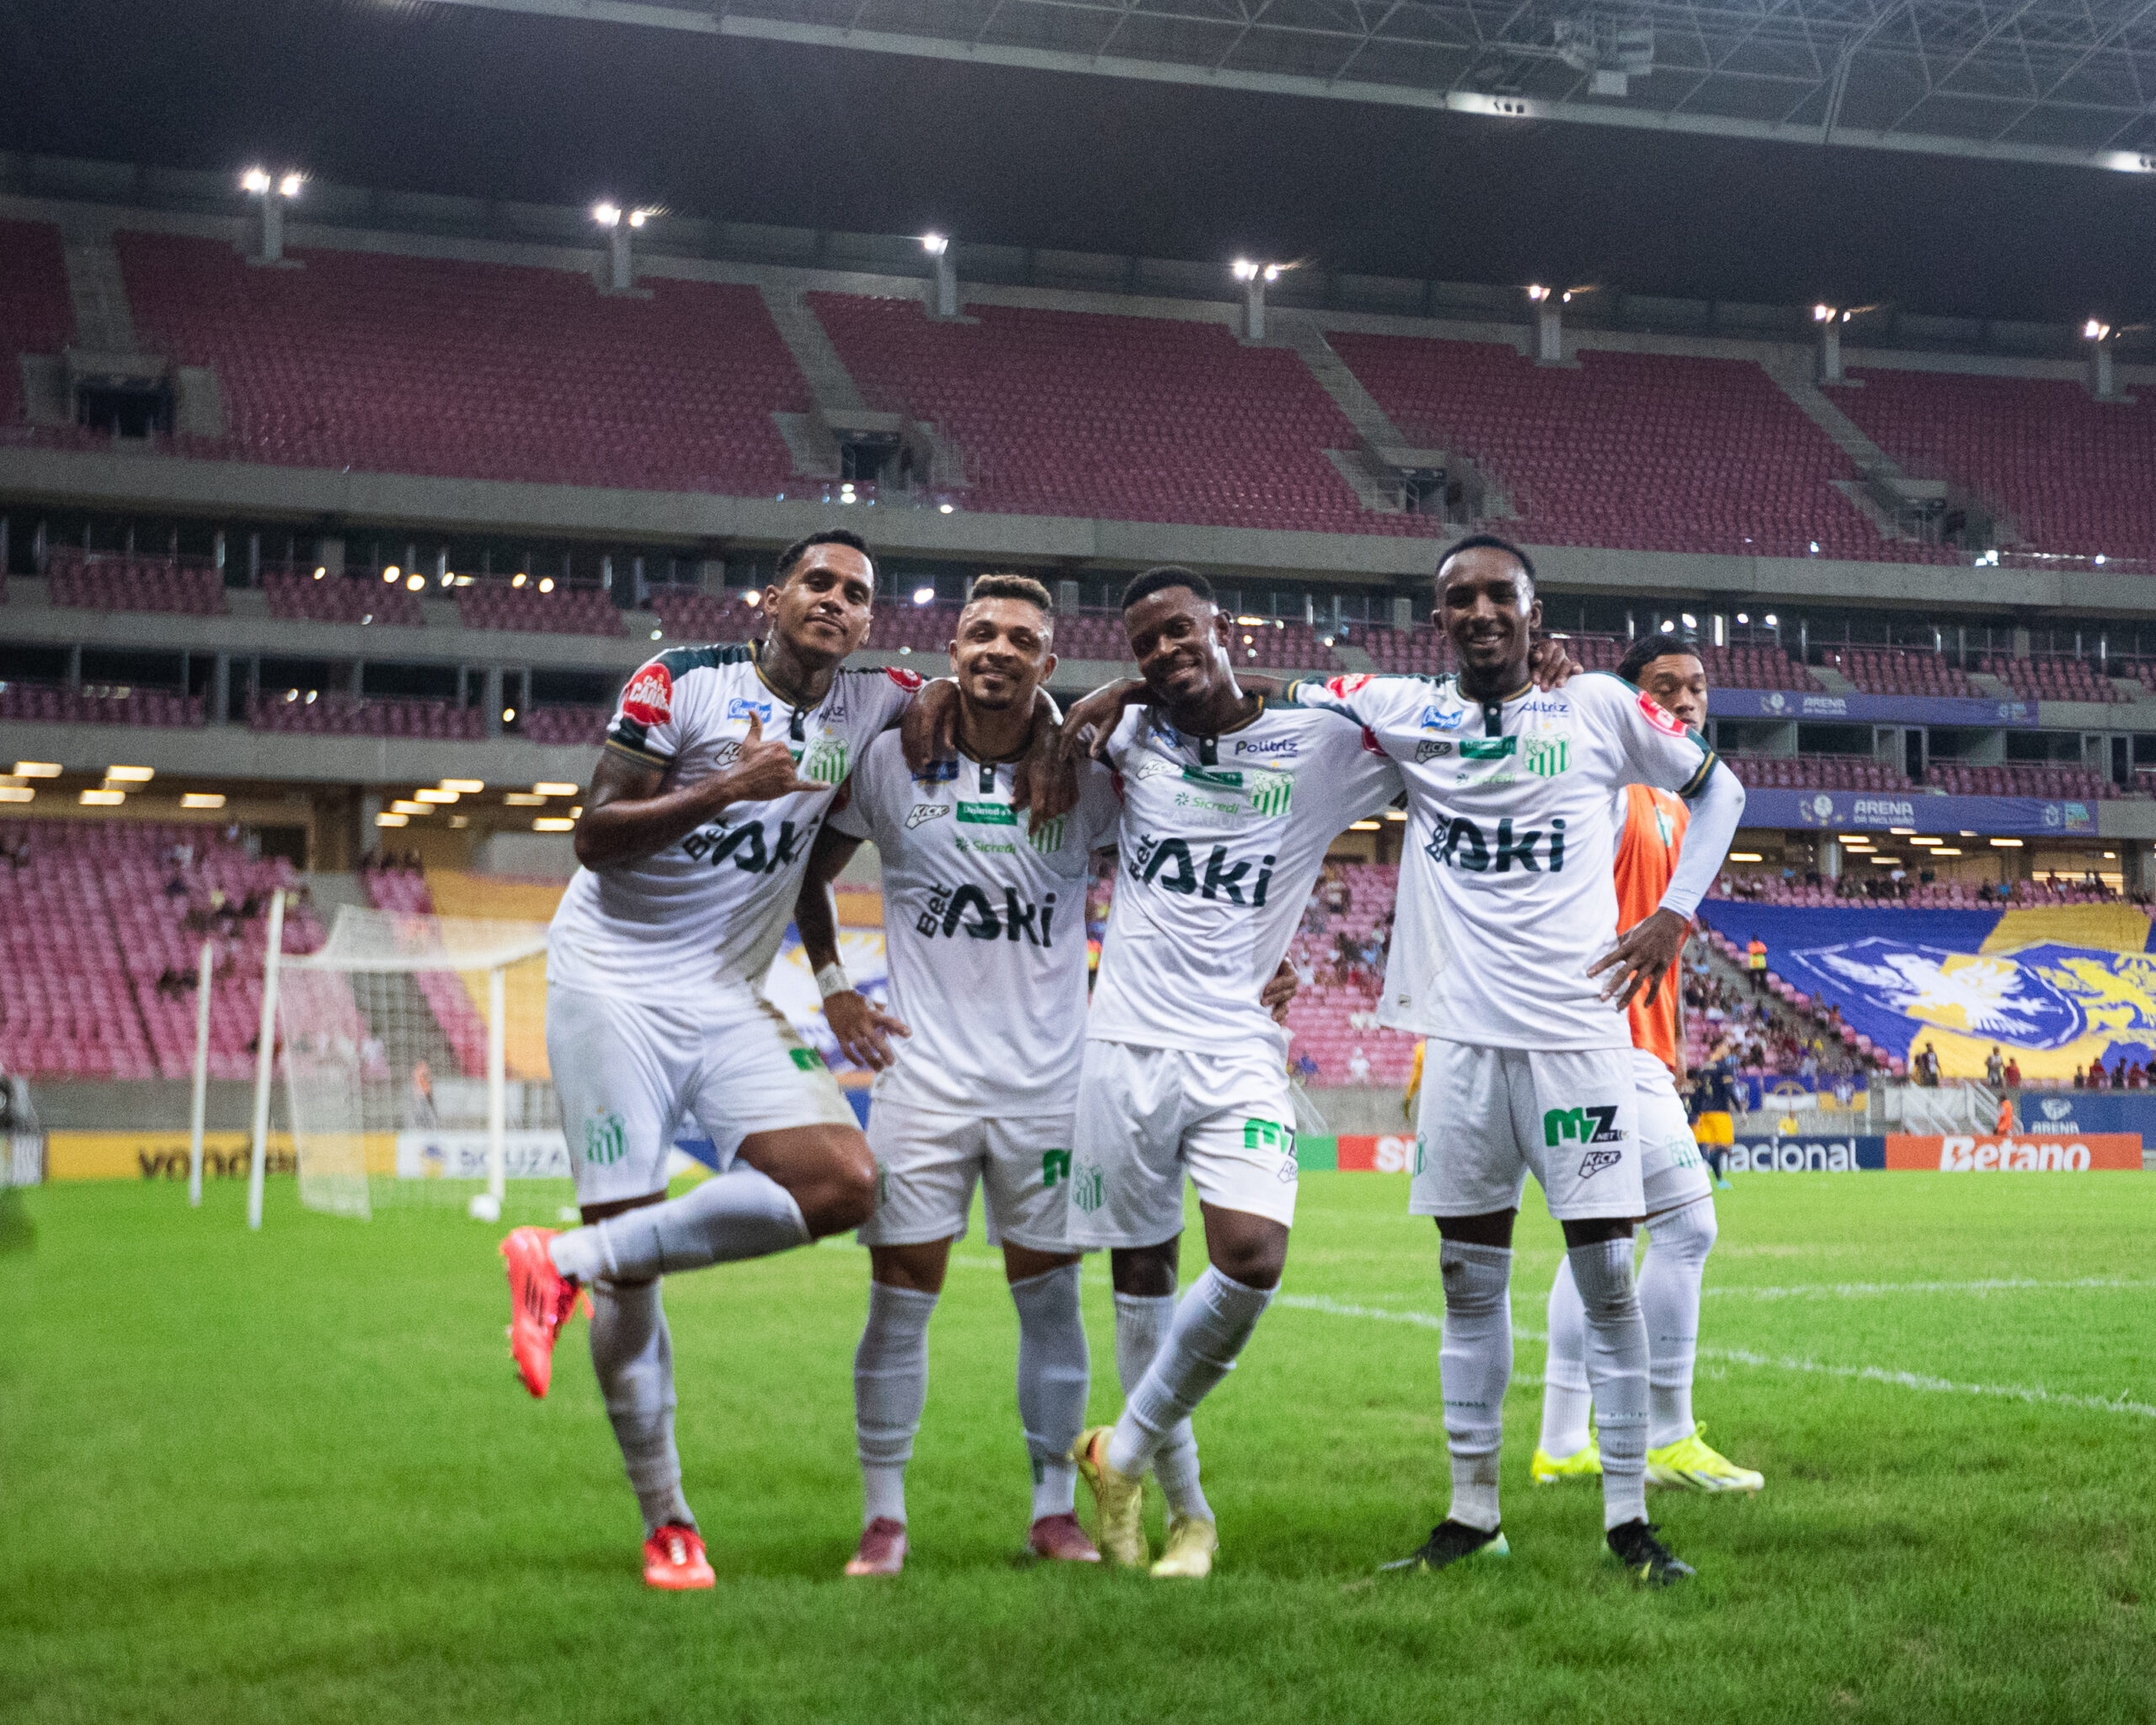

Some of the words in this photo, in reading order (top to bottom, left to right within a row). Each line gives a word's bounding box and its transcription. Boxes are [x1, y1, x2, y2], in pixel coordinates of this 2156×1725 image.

[1854, 799, 1914, 815] ARENA
[916, 884, 953, 938] Bet
[1940, 1137, 2091, 1172] Betano
